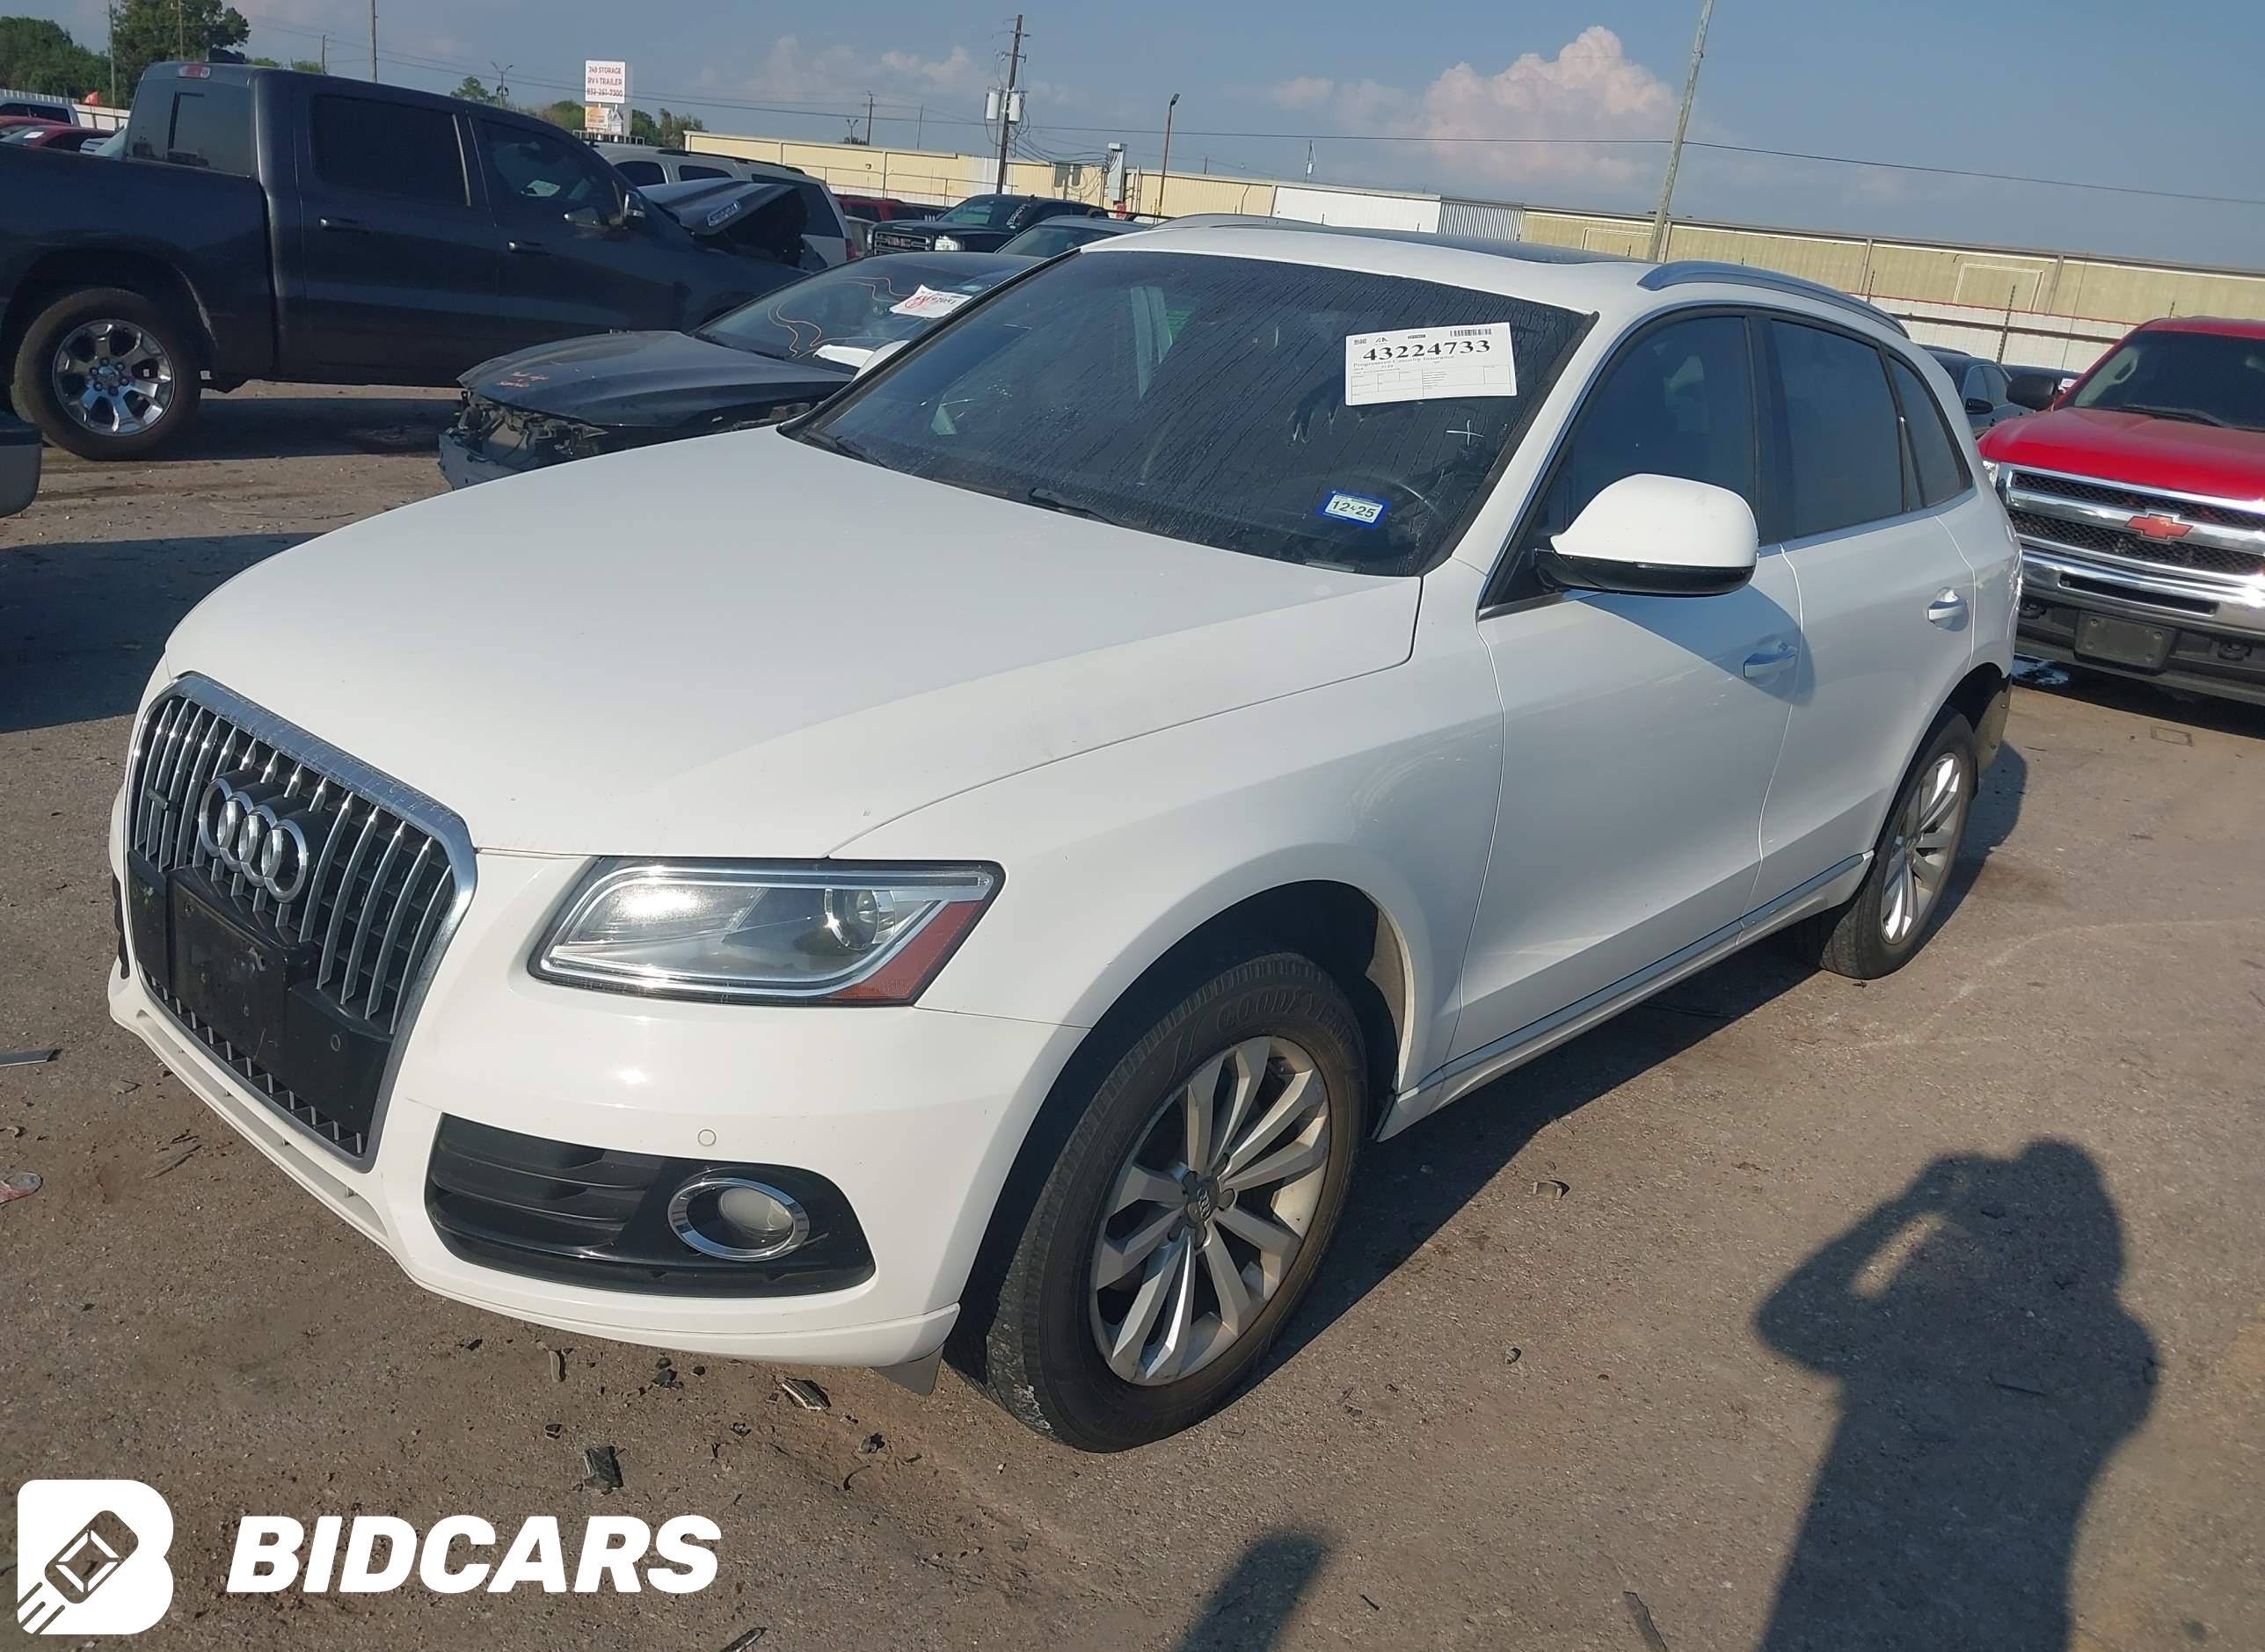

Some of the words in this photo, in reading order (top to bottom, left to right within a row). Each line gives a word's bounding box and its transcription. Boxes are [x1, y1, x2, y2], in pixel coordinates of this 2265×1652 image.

[1363, 339, 1490, 360] 43224733
[1333, 500, 1351, 513] 12
[1355, 506, 1377, 518] 25
